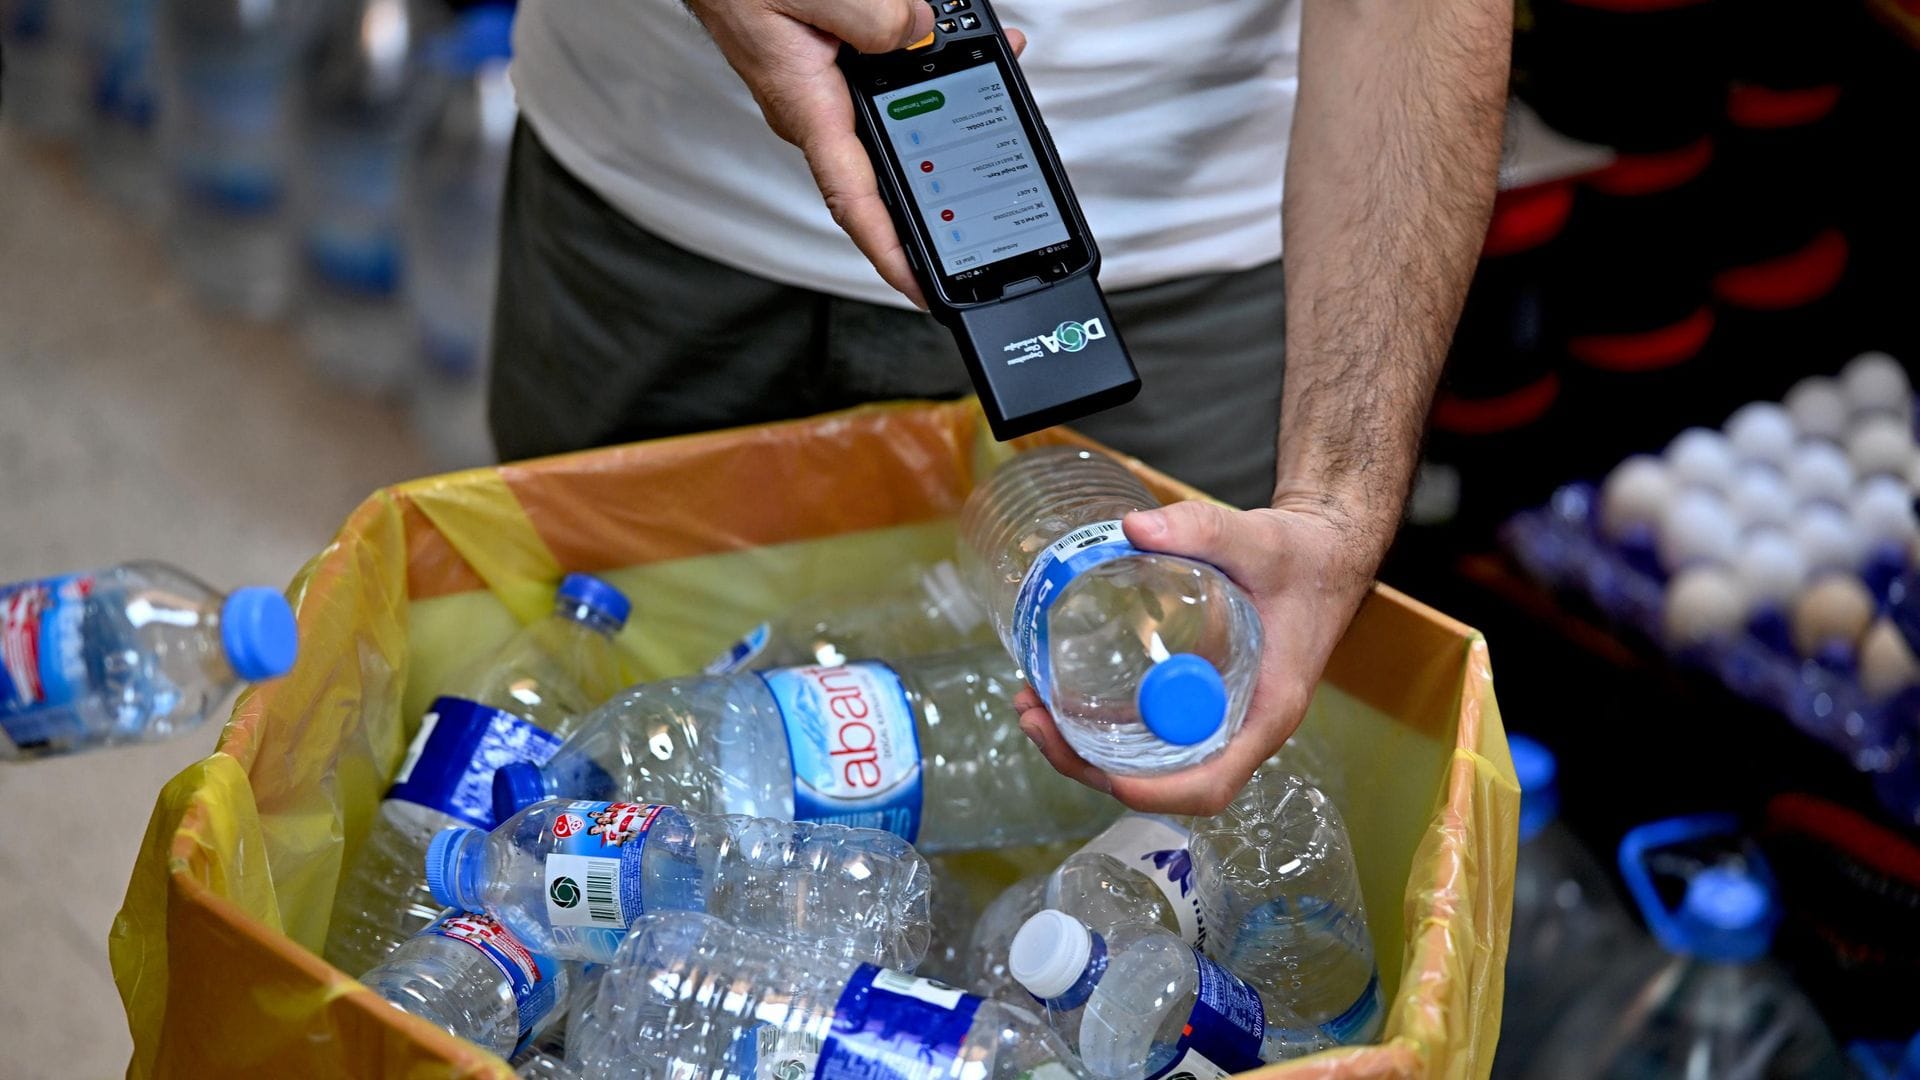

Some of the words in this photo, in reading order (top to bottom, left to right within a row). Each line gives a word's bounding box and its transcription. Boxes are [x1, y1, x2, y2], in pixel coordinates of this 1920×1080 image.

[990, 82, 1000, 91] 22
[995, 139, 1010, 148] ADET
[1011, 137, 1017, 145] 3
[1016, 187, 1031, 197] ADET
[1031, 185, 1038, 193] 6
[1024, 344, 1040, 352] Olan
